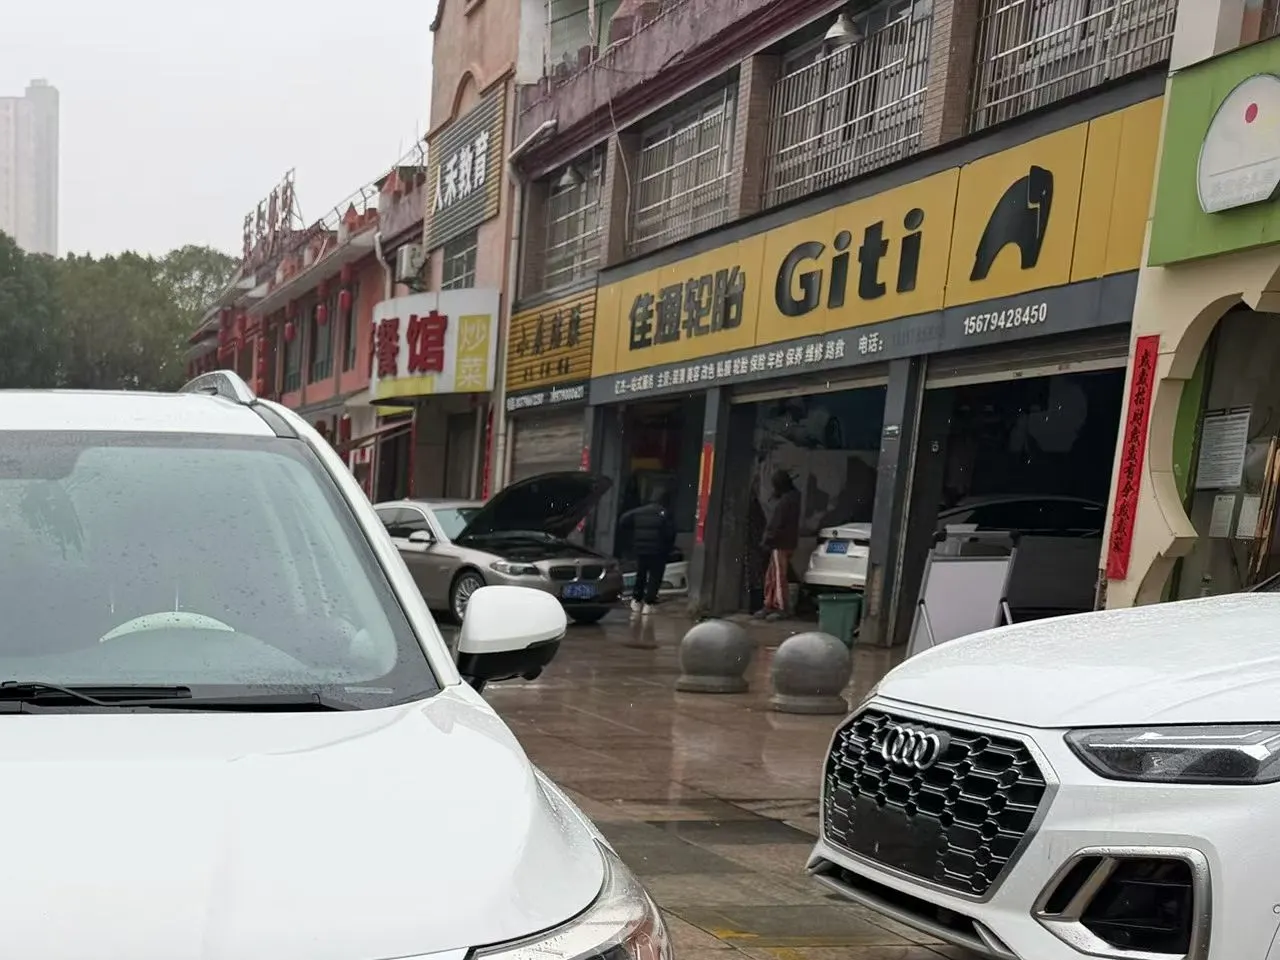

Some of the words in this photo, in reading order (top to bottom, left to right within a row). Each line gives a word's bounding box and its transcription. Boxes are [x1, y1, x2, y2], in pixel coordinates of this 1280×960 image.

[775, 208, 925, 318] Giti
[629, 265, 746, 352] 佳通轮胎
[767, 350, 785, 369] 年检
[785, 346, 804, 367] 保养
[805, 342, 824, 363] 维修
[963, 303, 1048, 335] 15679428450
[368, 309, 449, 379] 餐馆
[459, 317, 487, 387] 炒菜
